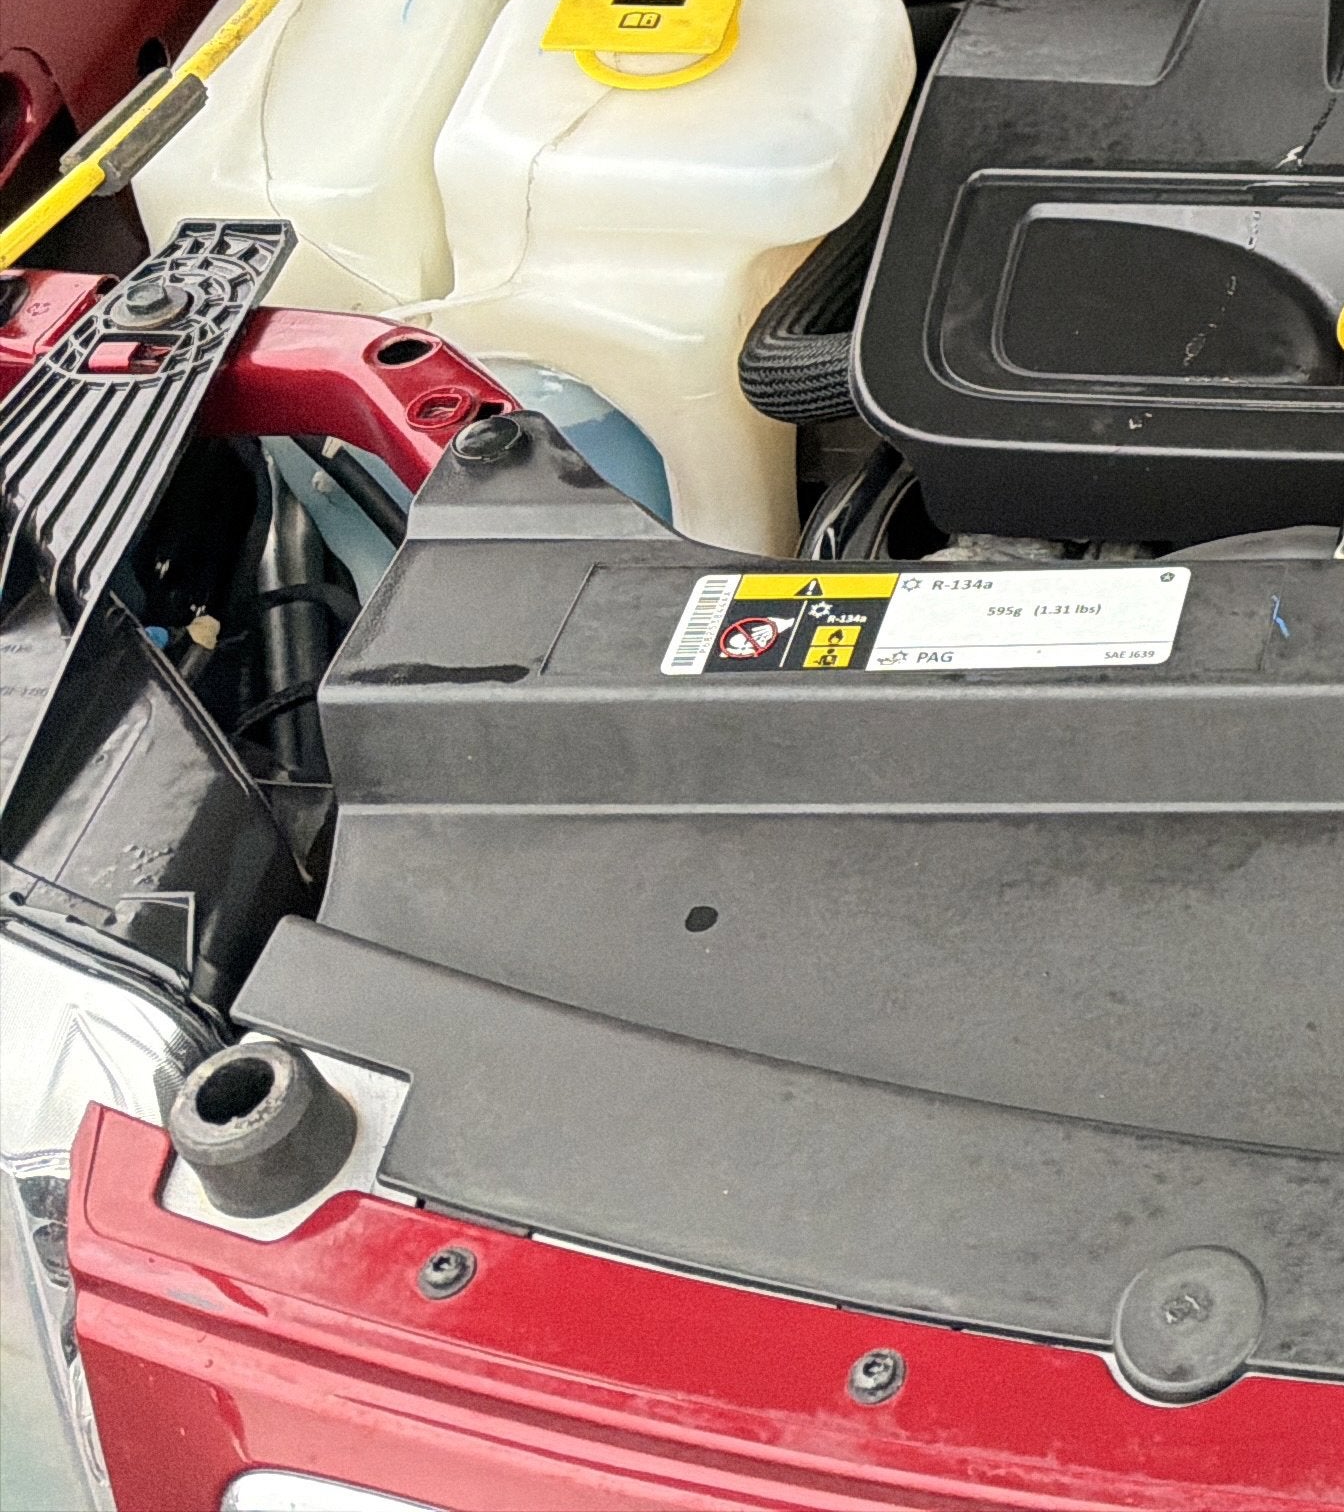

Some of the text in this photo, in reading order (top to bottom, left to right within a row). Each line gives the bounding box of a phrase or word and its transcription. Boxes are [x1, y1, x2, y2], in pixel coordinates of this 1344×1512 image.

[931, 579, 994, 591] R-134a
[986, 603, 1102, 618] 595g (1.31 lbs)
[826, 613, 868, 624] R-134a
[916, 651, 955, 664] PAG
[1104, 649, 1156, 660] SAE J639
